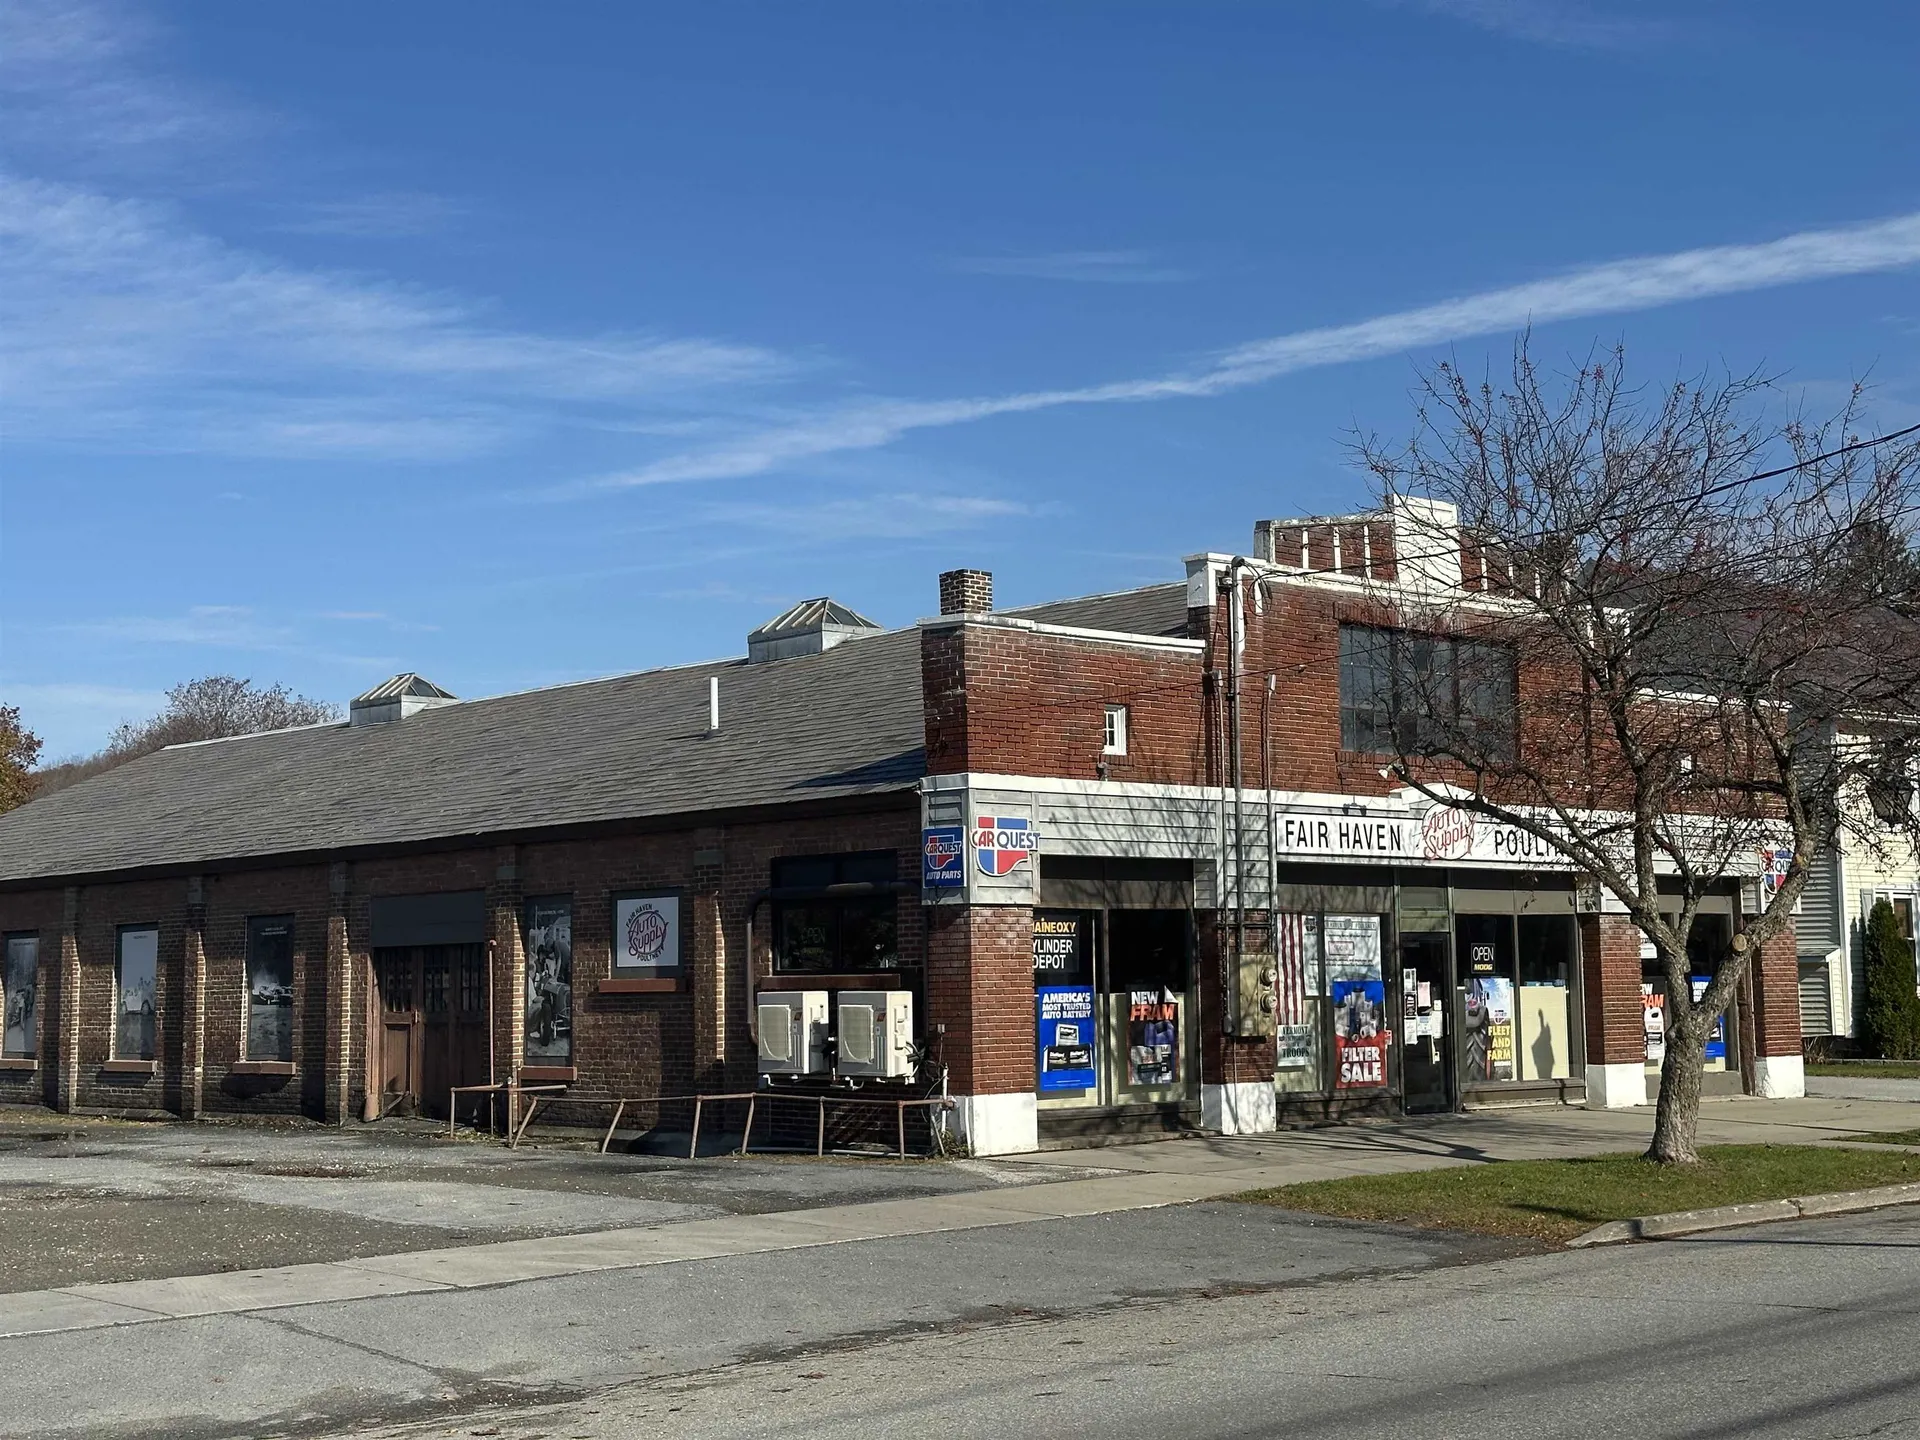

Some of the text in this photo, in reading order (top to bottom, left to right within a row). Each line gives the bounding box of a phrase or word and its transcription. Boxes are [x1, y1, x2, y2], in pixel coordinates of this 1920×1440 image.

[1421, 808, 1461, 833] AUTO
[1285, 820, 1401, 851] FAIR HAVEN
[926, 870, 962, 880] AUTO PARTS
[635, 903, 653, 916] HAVEN
[628, 911, 659, 936] AUTO
[1033, 938, 1074, 954] YLINDER
[1472, 946, 1494, 961] OPEN
[1042, 992, 1091, 1005] AMERICA'S
[1131, 991, 1159, 1005] NEW
[1641, 994, 1665, 1008] RAM
[1042, 1002, 1091, 1012] MOST TRUSTED
[1130, 1004, 1175, 1021] FRAM
[1042, 1010, 1091, 1020] AUTO BATTERY
[1488, 1025, 1511, 1037] FLEET
[1491, 1037, 1511, 1049] AND
[1282, 1047, 1310, 1058] TROOPS
[1341, 1047, 1381, 1063] FILTER
[1486, 1049, 1512, 1061] FARM
[1340, 1062, 1382, 1083] SALE
